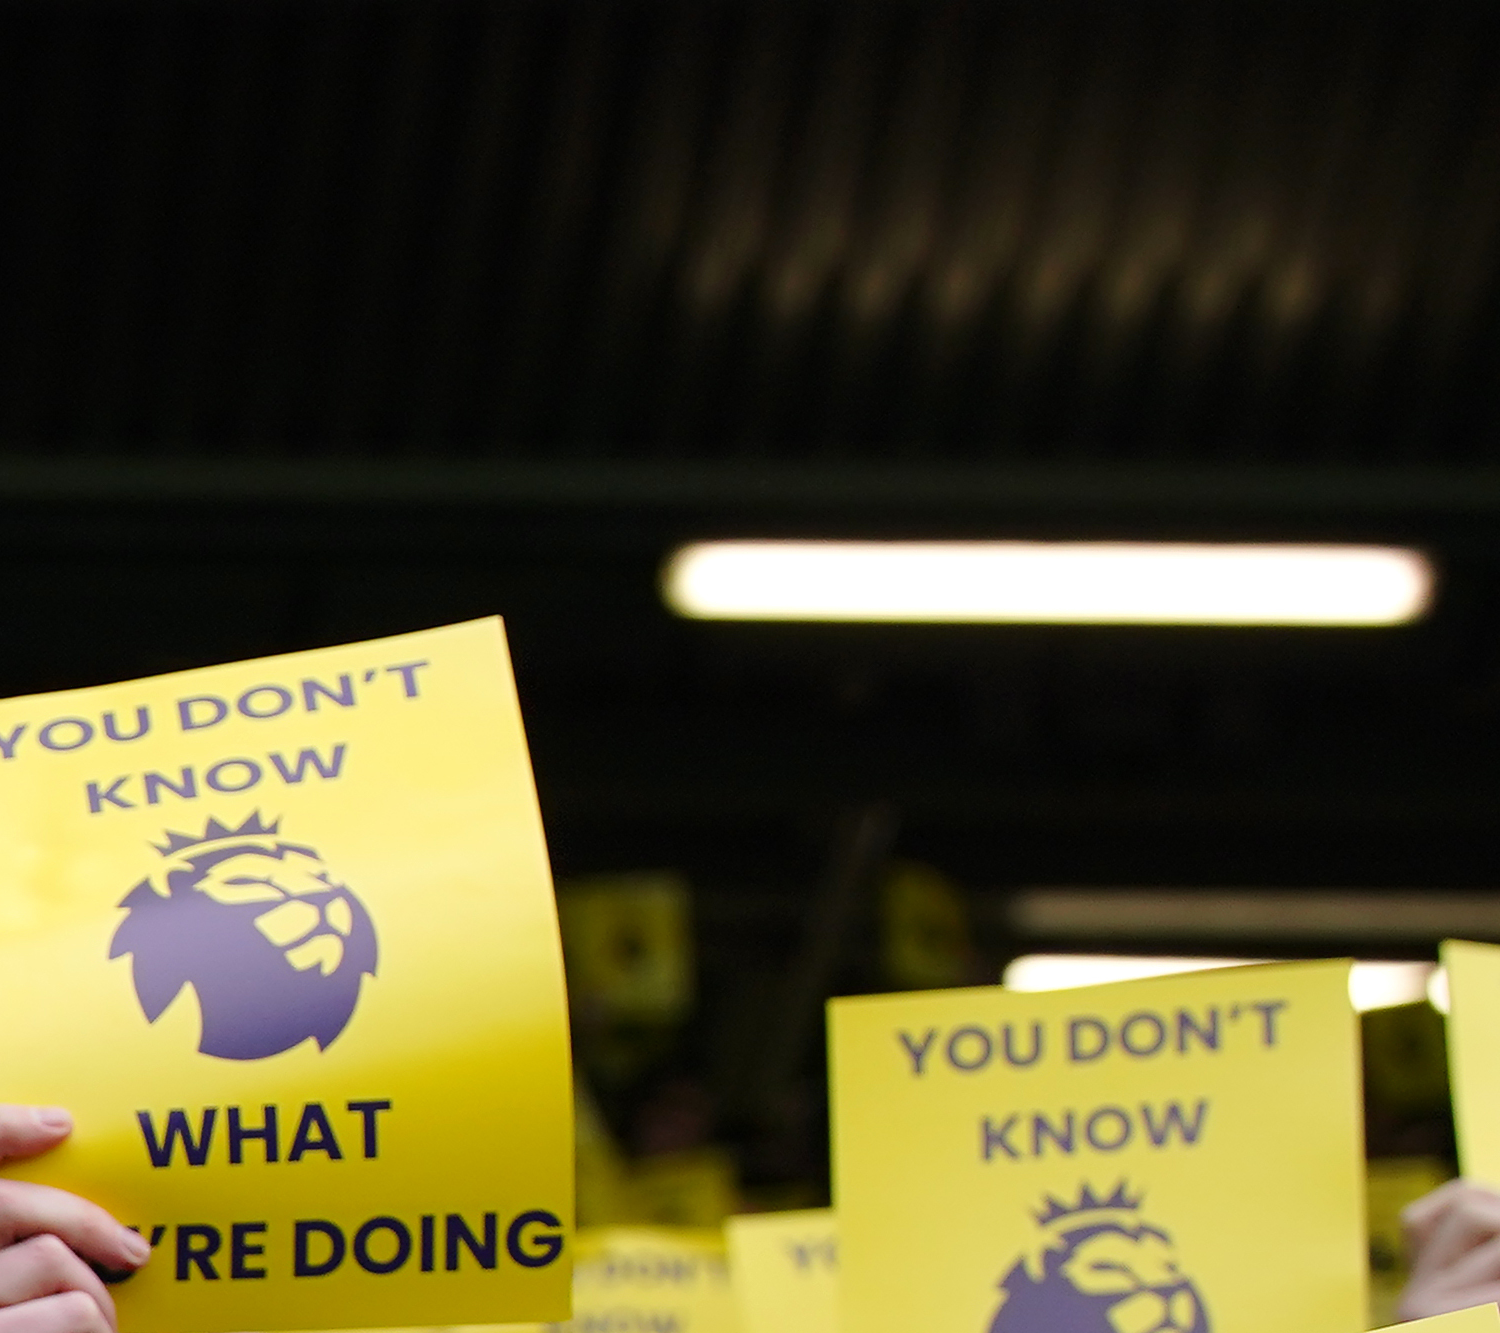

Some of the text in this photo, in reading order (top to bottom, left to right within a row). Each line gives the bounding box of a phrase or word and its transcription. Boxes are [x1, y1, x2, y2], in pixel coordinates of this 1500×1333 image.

[177, 661, 431, 732] DON'T
[85, 743, 349, 815] KNOW
[899, 1001, 1285, 1076] YOU DON'T
[138, 1100, 391, 1168] WHAT
[982, 1101, 1207, 1161] KNOW
[101, 1210, 563, 1284] 'RE DOING
